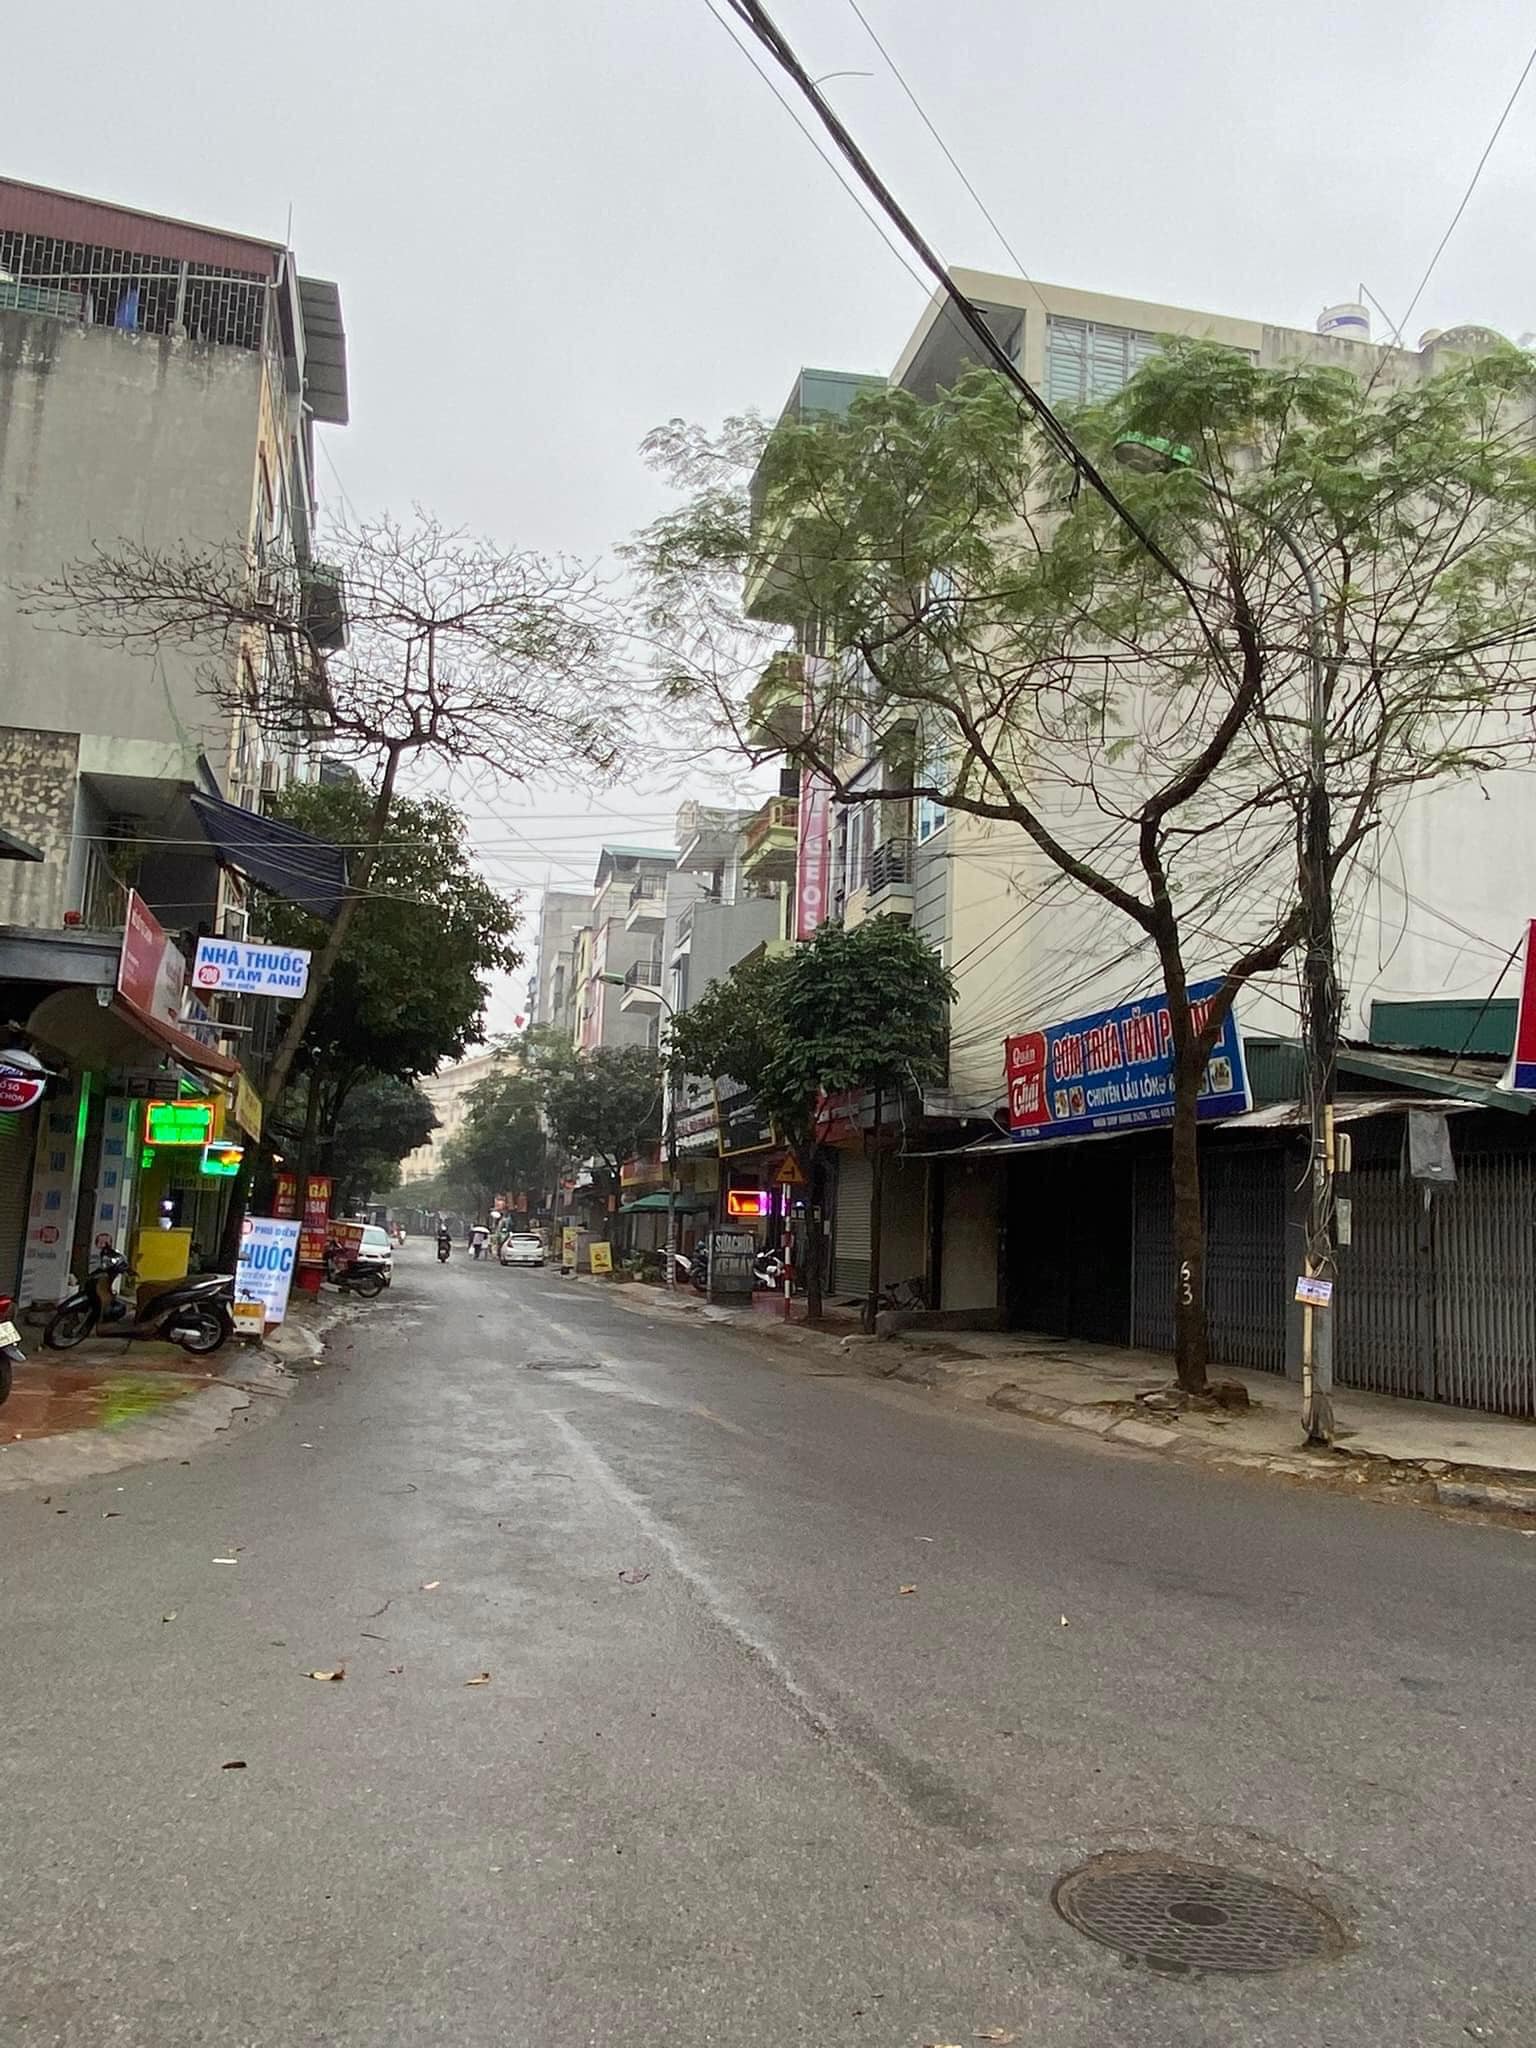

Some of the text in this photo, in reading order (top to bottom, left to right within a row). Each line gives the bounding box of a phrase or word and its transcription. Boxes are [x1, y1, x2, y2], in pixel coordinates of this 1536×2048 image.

[201, 946, 304, 973] NHÀ THUỐC
[227, 967, 301, 987] TÂM ANH
[1087, 1080, 1121, 1108] CHUYÊN
[240, 1237, 292, 1272] HUỐC
